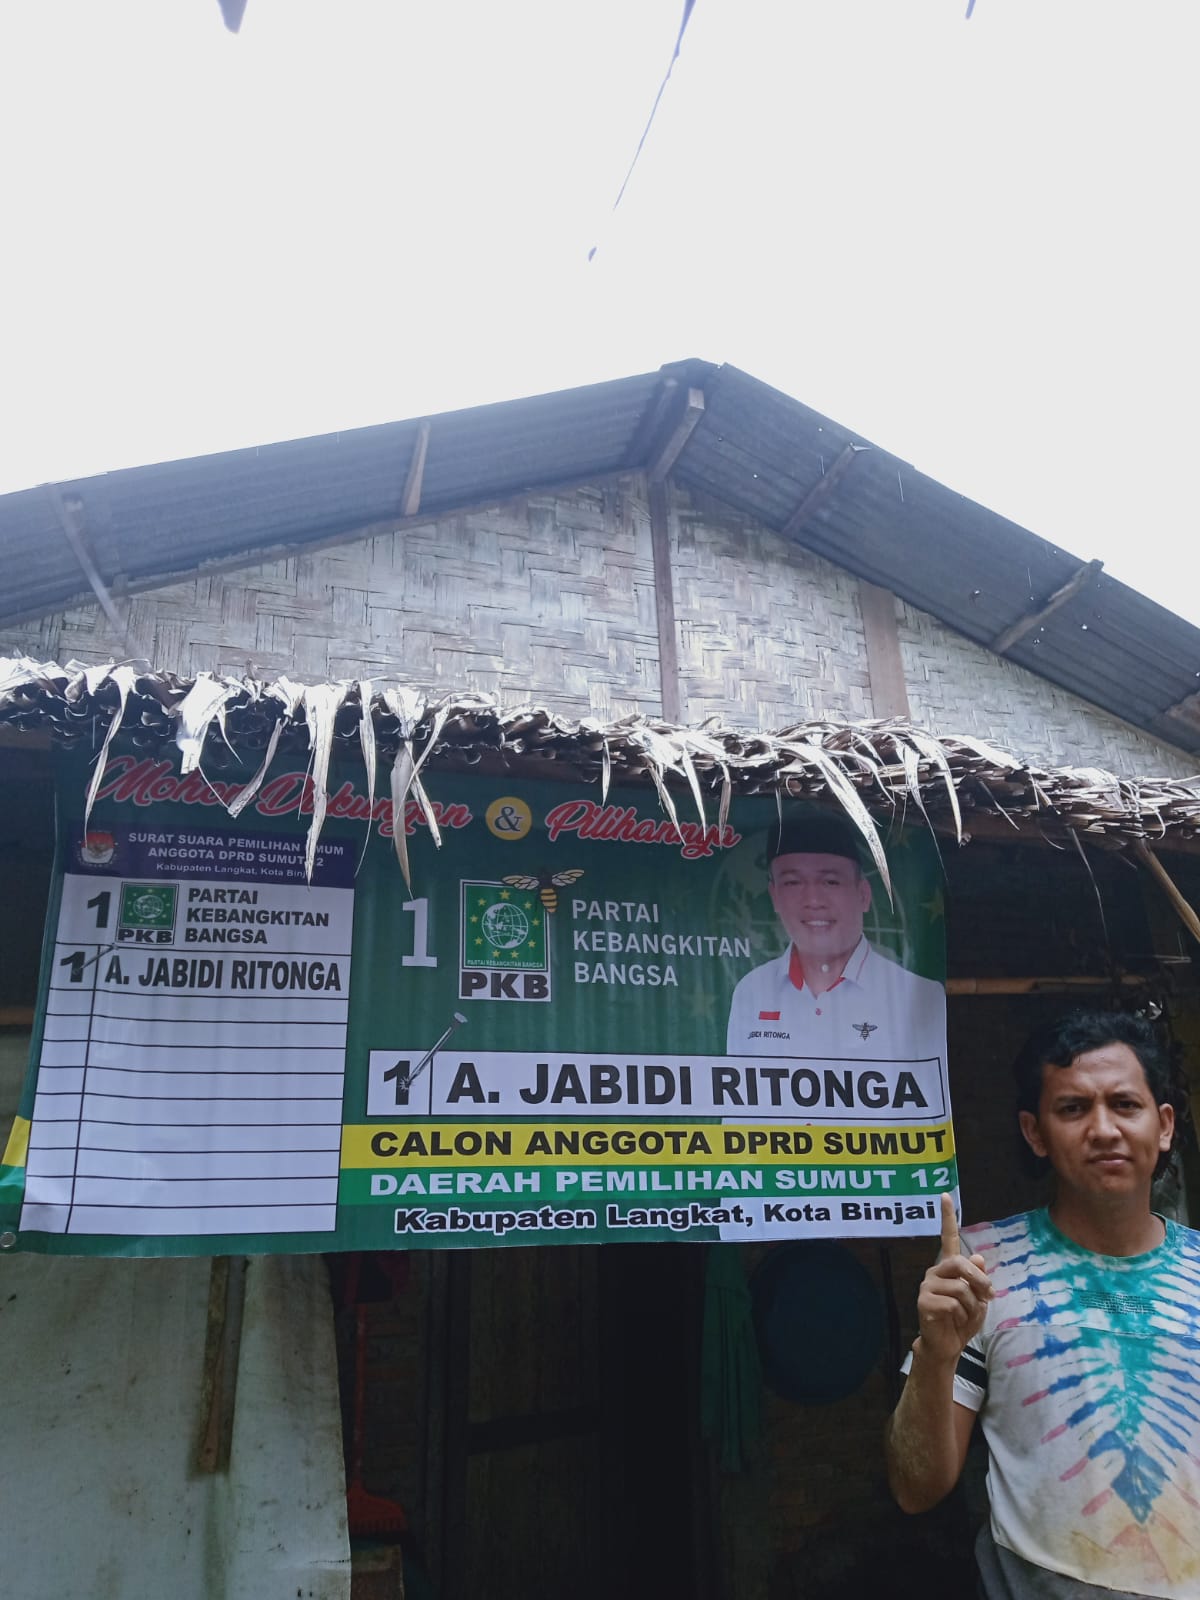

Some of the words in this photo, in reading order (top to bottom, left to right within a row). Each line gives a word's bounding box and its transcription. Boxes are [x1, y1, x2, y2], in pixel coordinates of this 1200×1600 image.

[255, 772, 473, 837] Dkungan
[493, 805, 524, 833] &
[545, 800, 742, 859] Pilihannya
[128, 832, 175, 843] SURAT
[178, 835, 224, 847] SUARA
[228, 838, 300, 852] PEMILIHAN
[305, 844, 344, 856] MUM
[147, 847, 215, 859] ANGGOTA
[219, 850, 255, 862] DPRD
[258, 853, 305, 865] SUMUT
[156, 863, 212, 873] Kabupaten
[214, 865, 258, 875] Langkat,
[261, 867, 284, 876] Kota
[286, 869, 313, 879] Binj
[188, 888, 258, 905] PARTAI
[87, 891, 111, 929] 1
[186, 907, 329, 927] KEBANGKITAN
[571, 899, 659, 923] PARTAI
[118, 929, 173, 943] PKB
[184, 928, 268, 945] BANGSA
[402, 898, 438, 968] 1
[573, 930, 751, 958] KEBANGKITAN
[60, 951, 86, 983] 1
[104, 955, 130, 985] A.
[138, 957, 223, 988] JABIDI
[231, 960, 342, 991] RITONGA
[574, 962, 679, 986] BANGSA
[461, 972, 549, 999] PKB
[763, 1031, 790, 1040] RITONGA
[384, 1060, 411, 1106] 1
[446, 1062, 500, 1104] A.
[519, 1063, 692, 1105] JABIDI
[711, 1066, 928, 1108] RITONGA
[371, 1131, 512, 1157] CALON
[525, 1131, 713, 1156] ANGGOTA
[724, 1131, 813, 1155] DPRD
[823, 1129, 947, 1155] SUMUT
[370, 1171, 541, 1196] DAERAH
[555, 1170, 763, 1193] PEMILIHAN
[775, 1170, 897, 1190] SUMUT
[911, 1167, 950, 1188] 12
[395, 1206, 596, 1235] Kabupaten
[606, 1203, 754, 1230] Langkat,
[764, 1203, 831, 1222] Kota
[841, 1201, 936, 1225] Binjai
